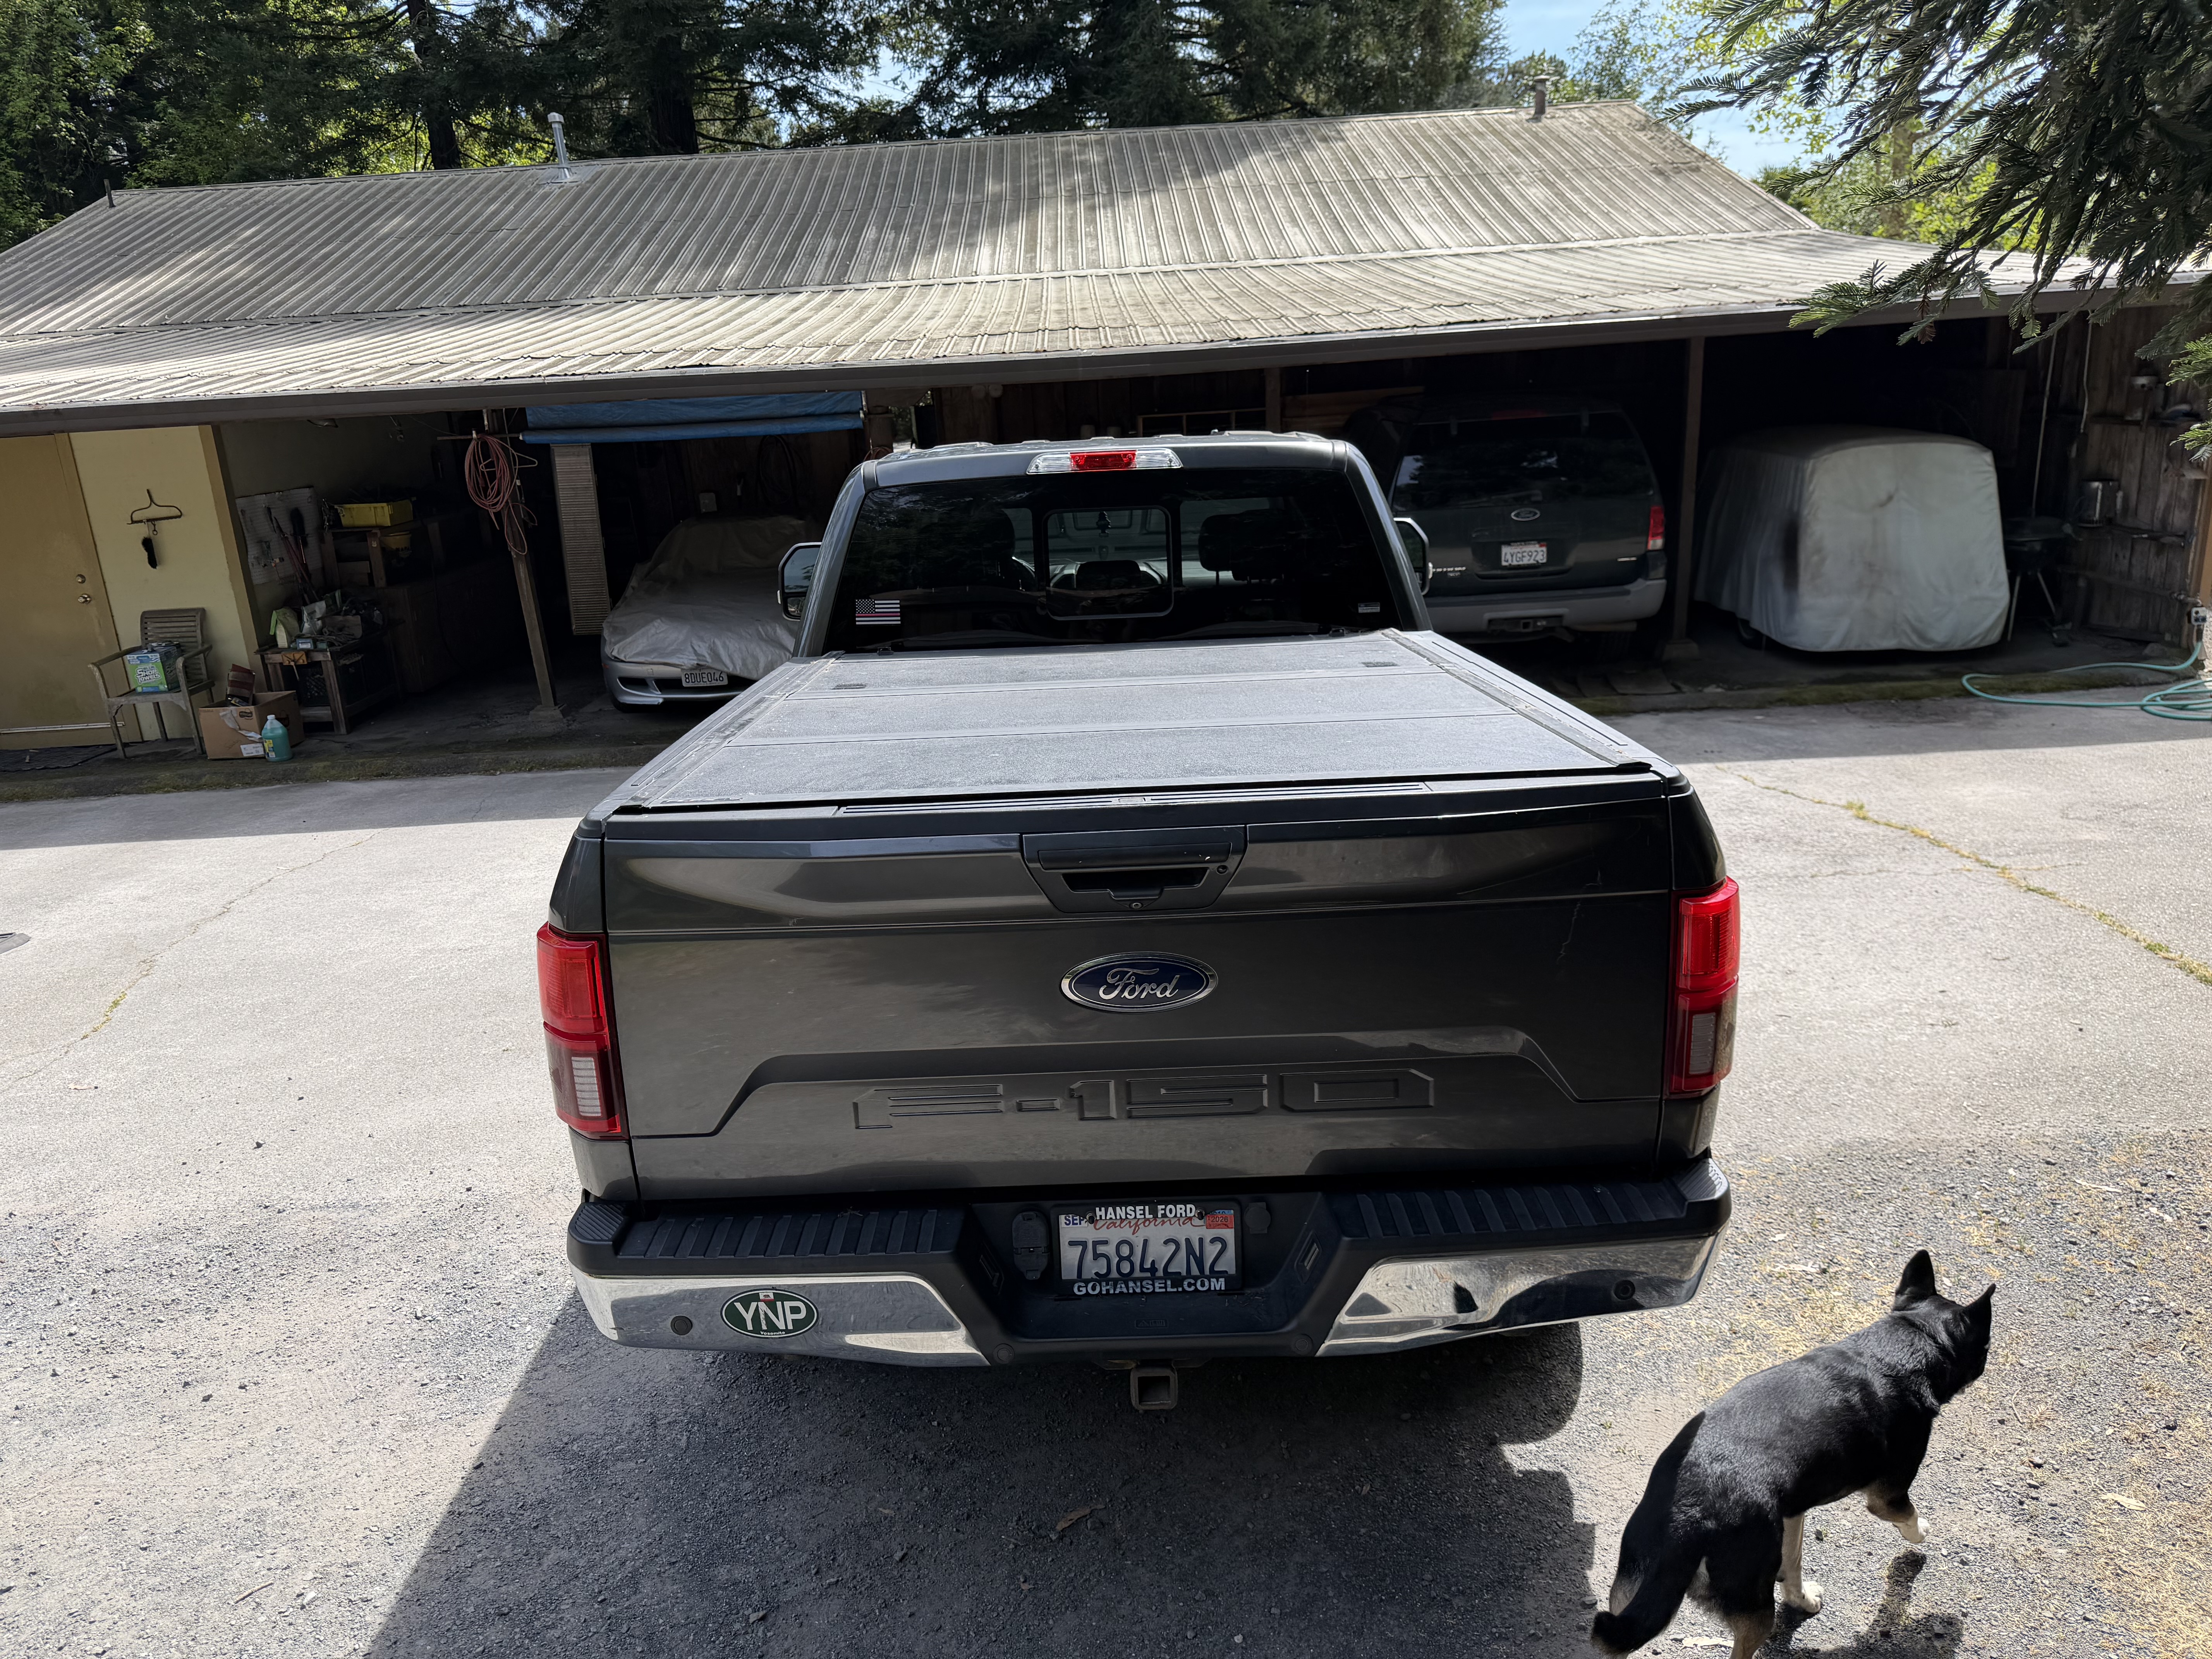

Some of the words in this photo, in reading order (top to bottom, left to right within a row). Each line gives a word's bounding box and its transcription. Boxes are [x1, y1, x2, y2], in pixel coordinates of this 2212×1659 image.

[136, 668, 158, 677] SHOP
[685, 672, 724, 683] 8DUE046
[1099, 968, 1180, 1000] Ford
[854, 1068, 1434, 1129] F-150
[1096, 1206, 1153, 1219] HANSEL
[1157, 1204, 1196, 1218] FORD
[1064, 1215, 1085, 1226] SEP
[1068, 1237, 1228, 1279] 75842N2
[1073, 1278, 1225, 1295] GOHANSEL.COM
[734, 1301, 806, 1330] YNP
